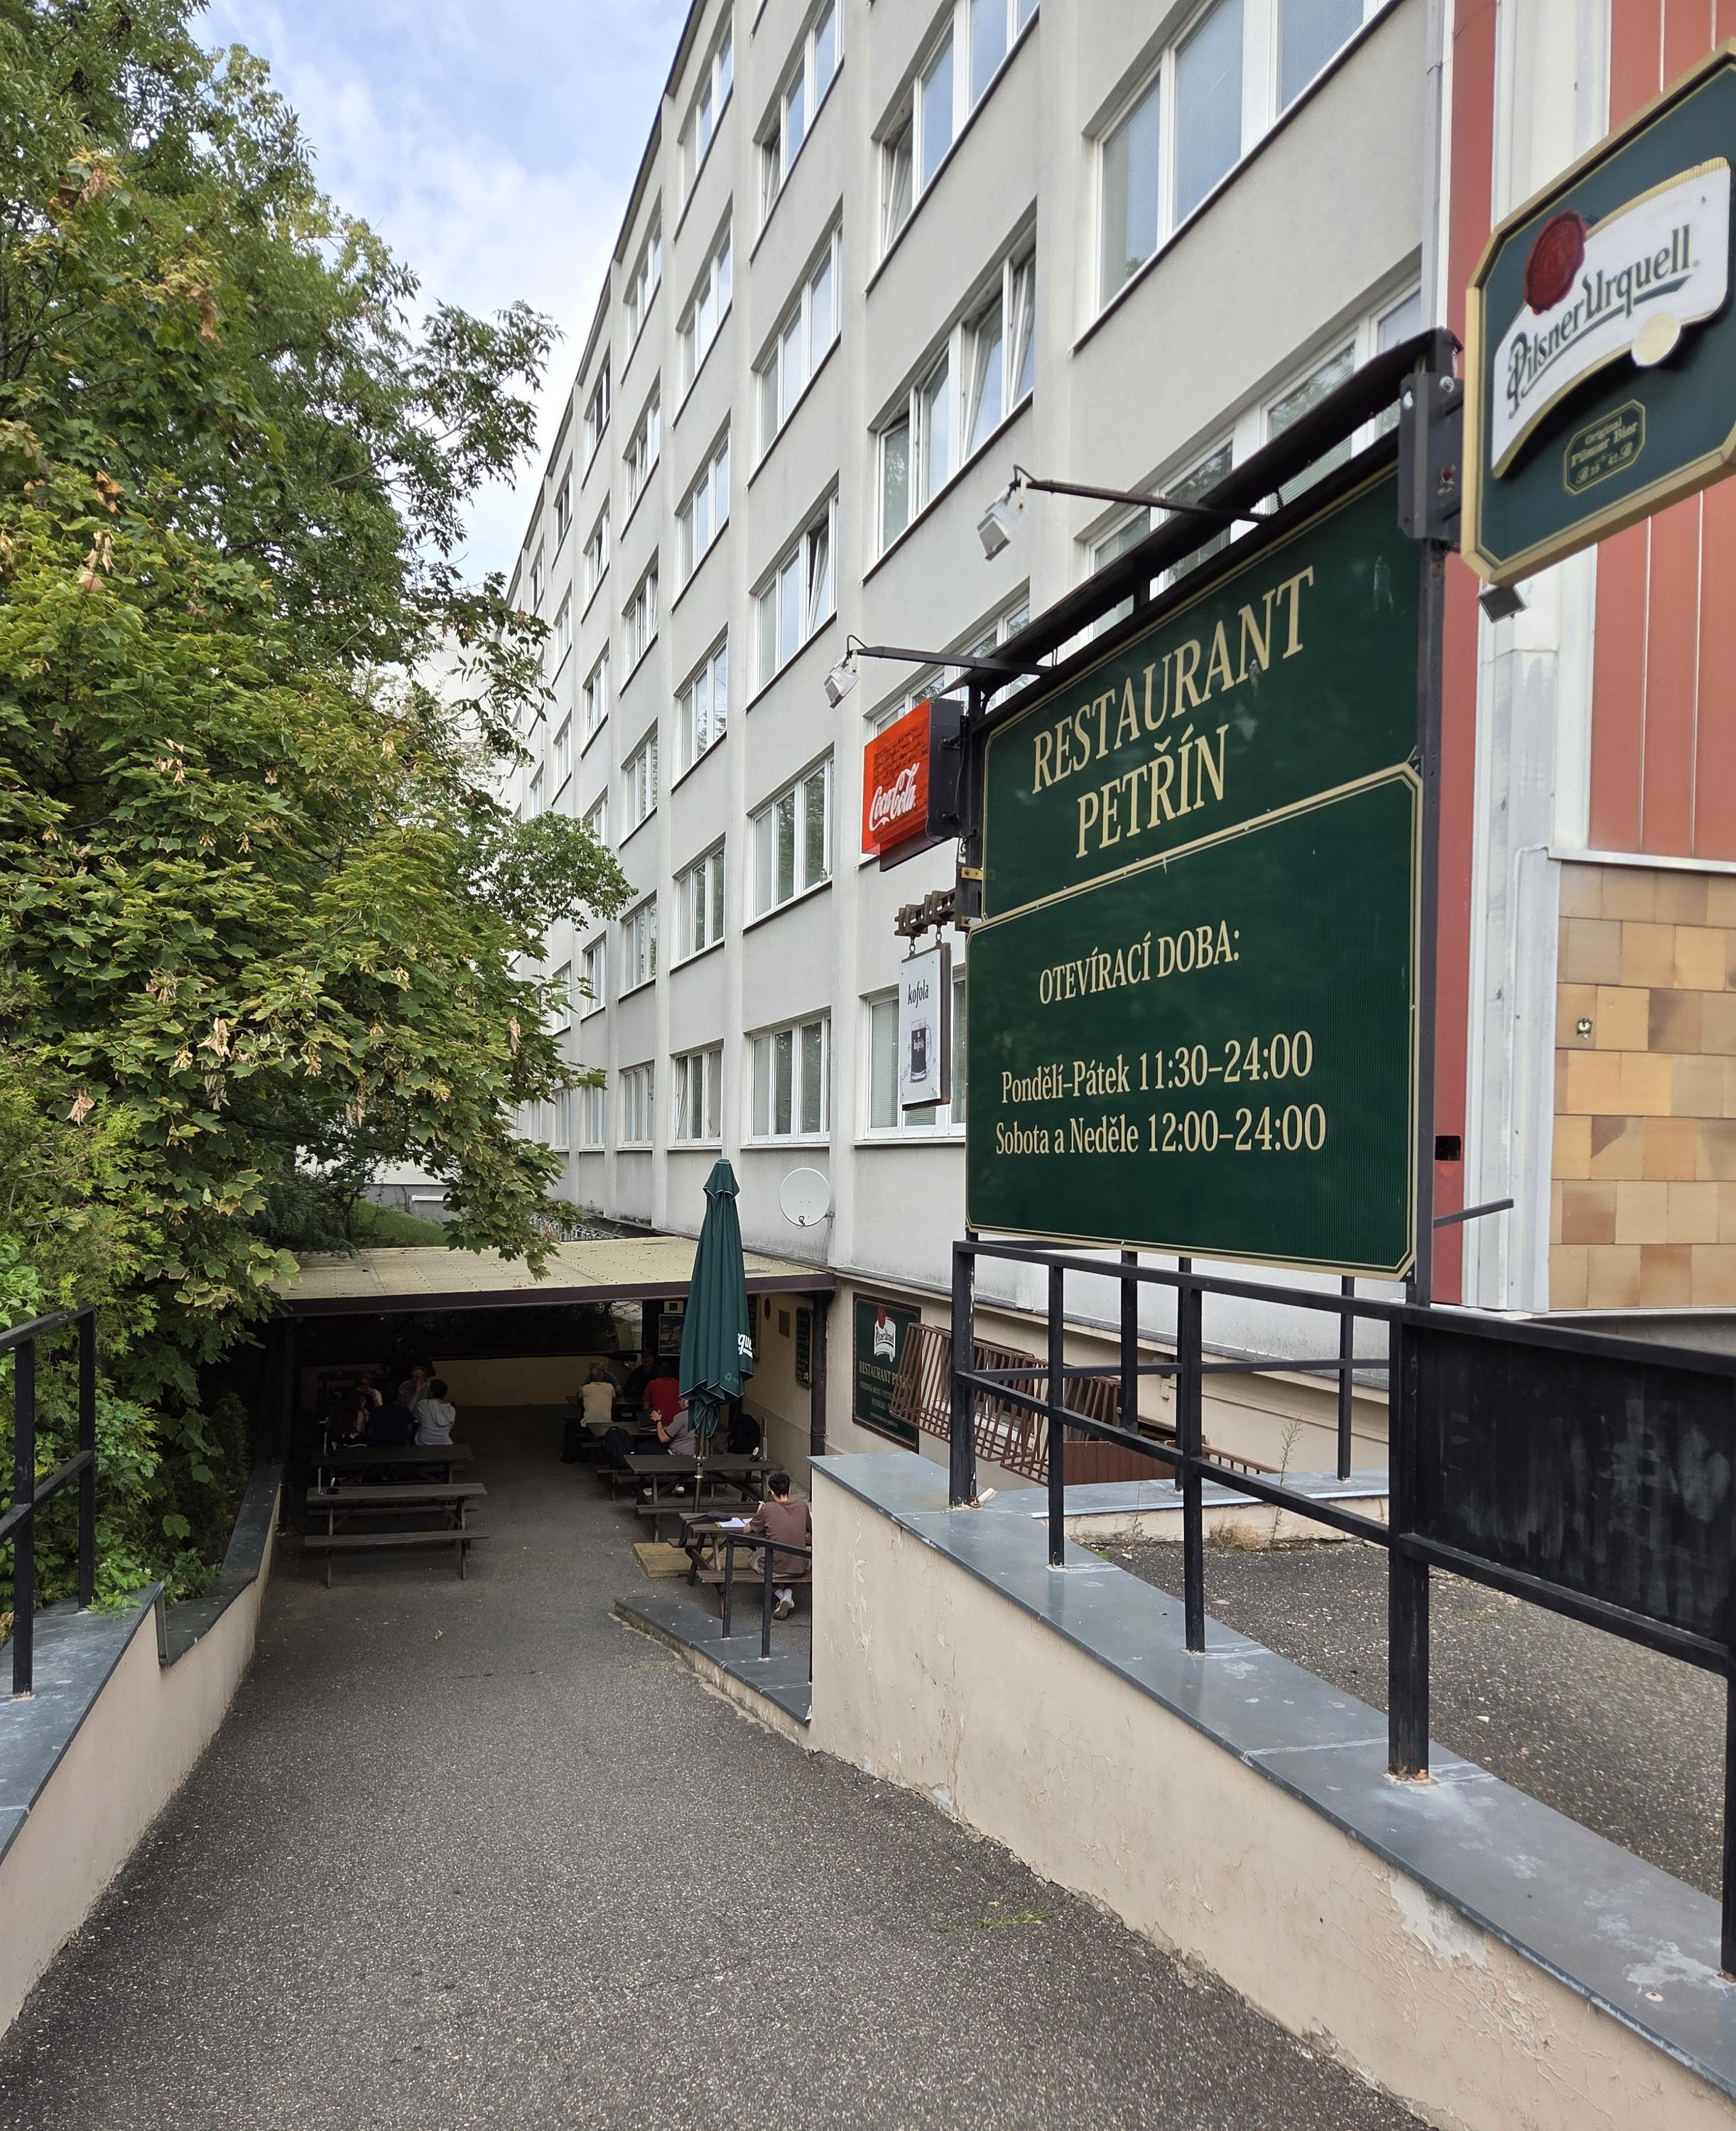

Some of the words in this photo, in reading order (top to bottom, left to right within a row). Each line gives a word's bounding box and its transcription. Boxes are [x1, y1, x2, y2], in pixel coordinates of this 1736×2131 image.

[1507, 297, 1584, 420] Pilsner
[1582, 223, 1691, 319] Urquell
[1031, 565, 1314, 794] RESTAURANT
[869, 761, 920, 832] Coca-Cola
[1075, 722, 1229, 858] PETŘÍN
[907, 979, 929, 1009] kofola
[1039, 931, 1151, 1004] OTEVÍRACÍ
[1157, 920, 1239, 977] DOBA:
[996, 1121, 1049, 1154] Sobota
[1054, 1127, 1065, 1154] a
[1070, 1114, 1139, 1154] Neděle
